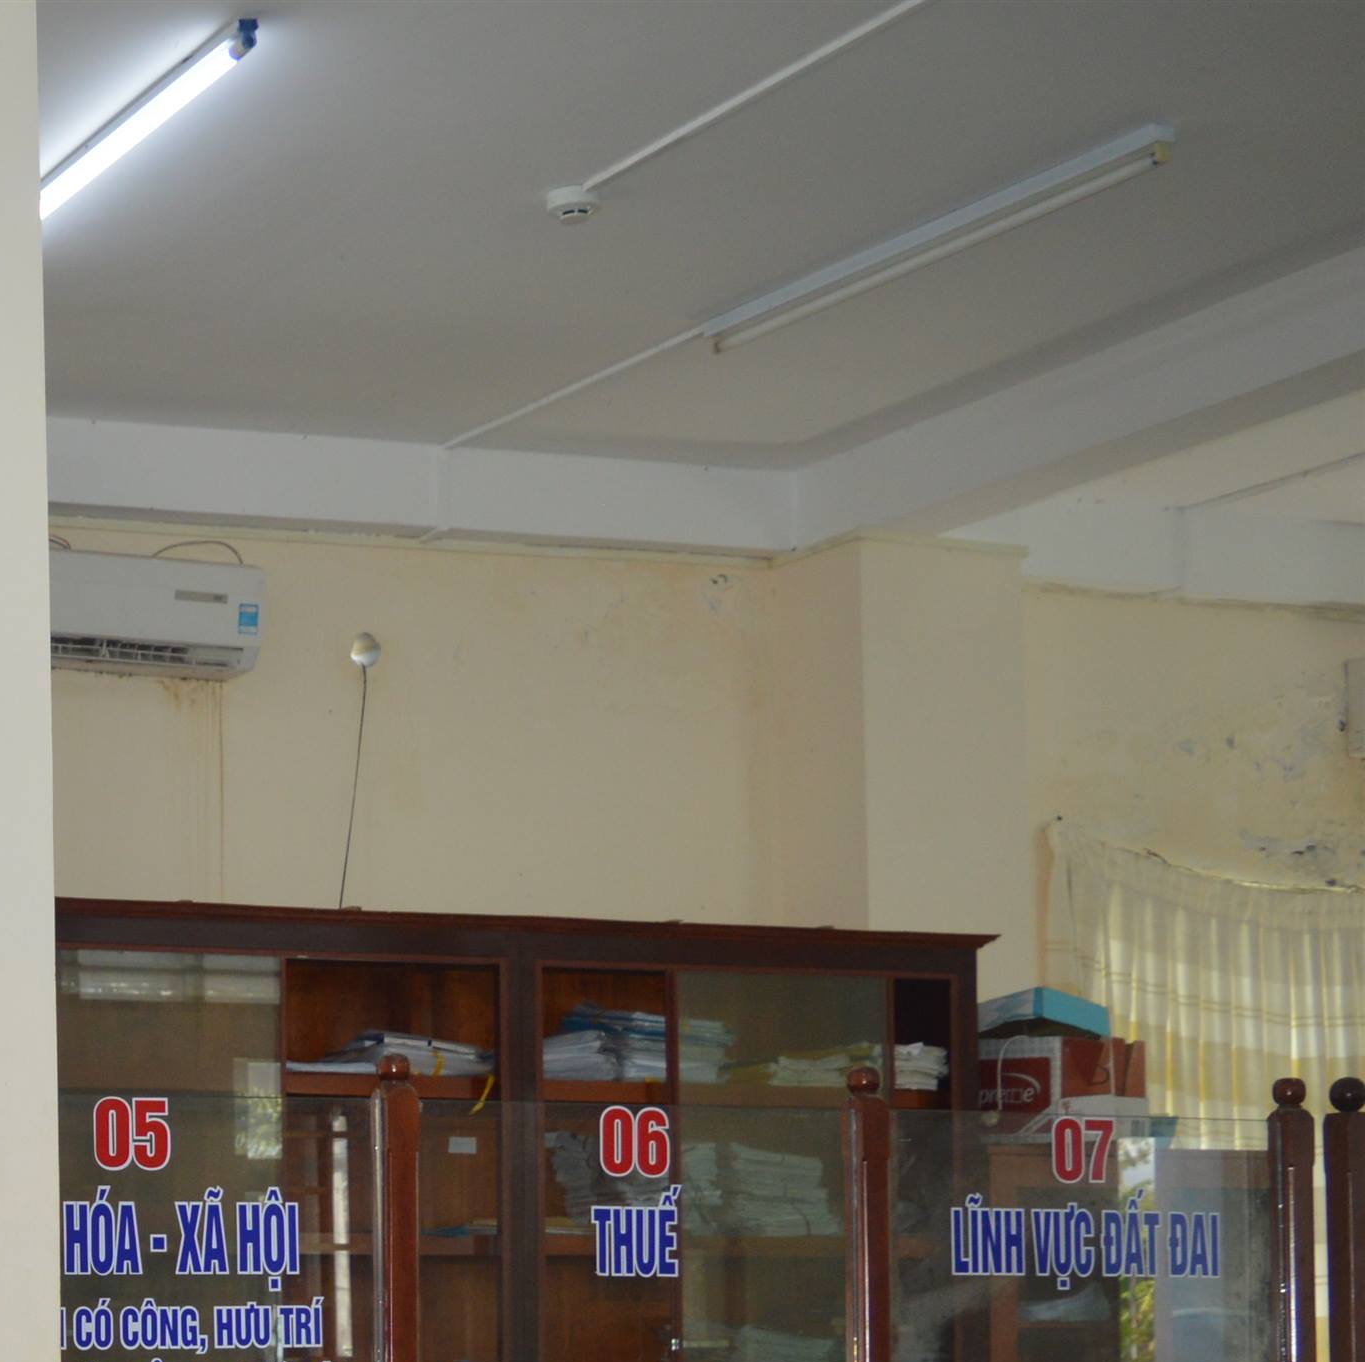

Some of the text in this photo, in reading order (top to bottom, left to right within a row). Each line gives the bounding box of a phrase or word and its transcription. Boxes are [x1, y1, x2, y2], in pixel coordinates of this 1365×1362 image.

[93, 1096, 171, 1171] 05
[599, 1105, 670, 1178] 06
[1051, 1116, 1116, 1183] 07
[63, 1185, 143, 1275] HÓA
[175, 1185, 229, 1275] XÃ
[236, 1186, 300, 1292] HỘI
[591, 1184, 682, 1277] THUẾ
[950, 1189, 1220, 1290] LĨNH VỰC ĐẤT ĐAI
[73, 1298, 114, 1350] CÓ
[120, 1298, 208, 1354] CÔNG,
[213, 1301, 272, 1349] HƯU
[277, 1296, 325, 1348] TRÍ
